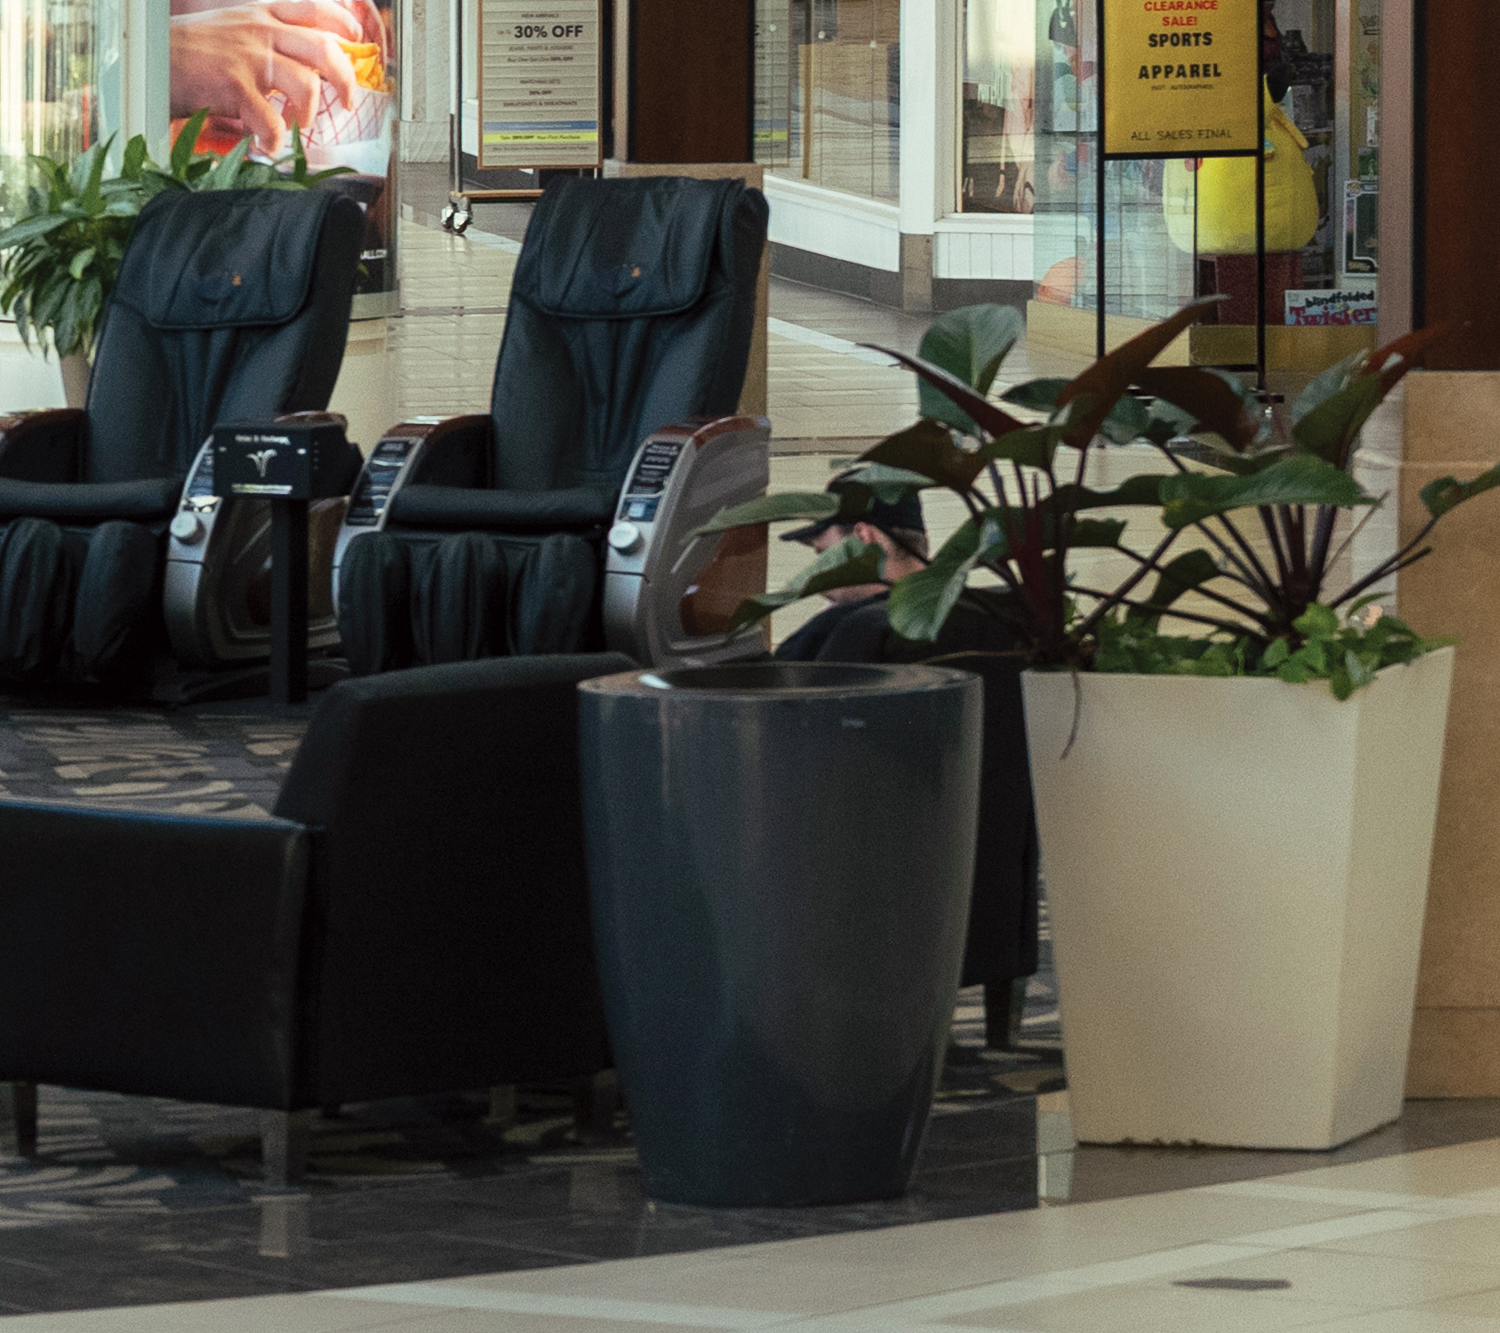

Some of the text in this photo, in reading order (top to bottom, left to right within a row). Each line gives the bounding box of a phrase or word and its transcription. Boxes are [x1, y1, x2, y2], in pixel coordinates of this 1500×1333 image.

[1143, 0, 1218, 12] CLEARANCE
[1161, 15, 1198, 27] SALE!
[514, 25, 548, 39] 30%
[551, 24, 584, 39] OFF
[1148, 31, 1213, 48] SPORTS
[1138, 62, 1222, 80] APPAREL
[1131, 128, 1233, 141] ALL SALES FINAL
[1304, 289, 1375, 308] blindfolded
